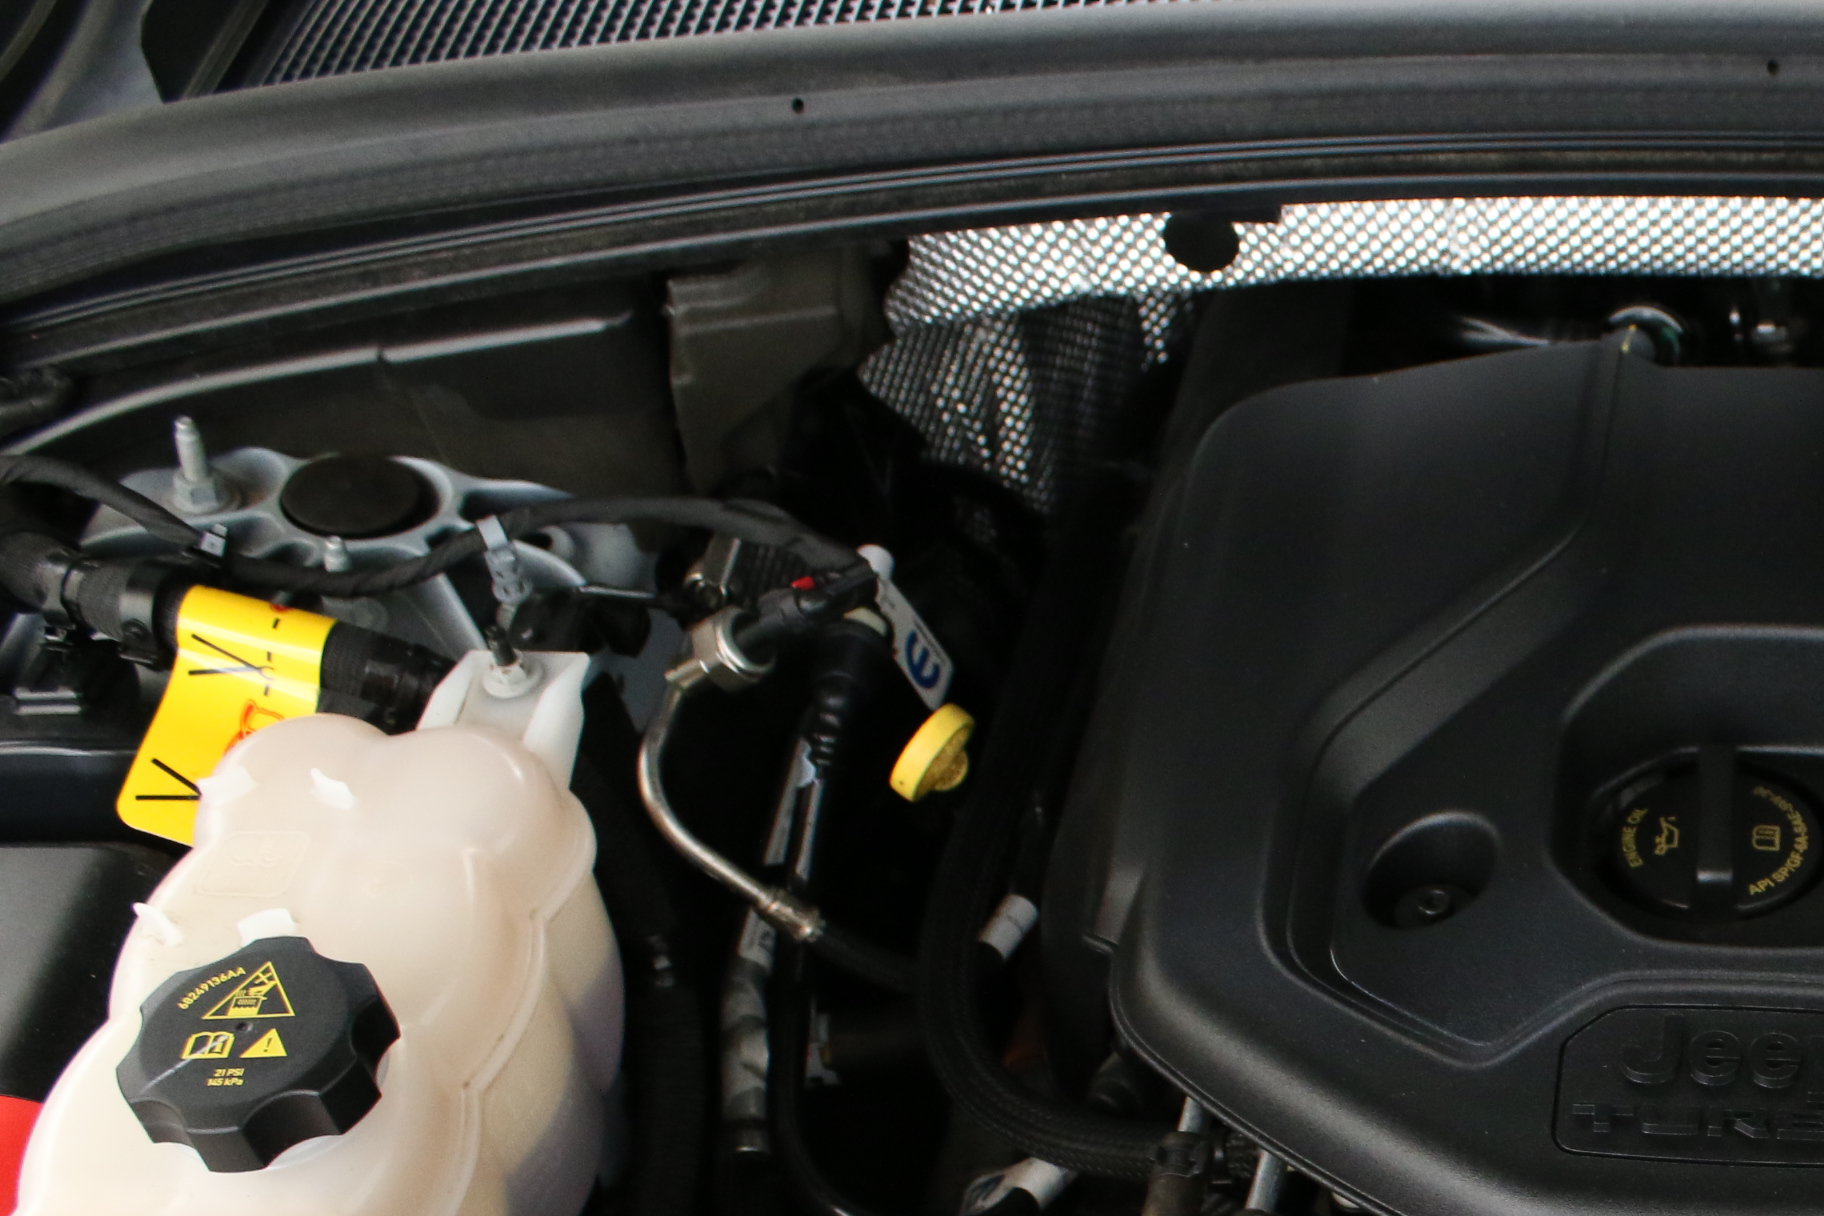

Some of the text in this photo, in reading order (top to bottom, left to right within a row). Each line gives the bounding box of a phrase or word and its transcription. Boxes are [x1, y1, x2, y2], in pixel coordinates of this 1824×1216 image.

[1620, 808, 1649, 868] ENGINE OIL
[1747, 877, 1775, 896] API
[177, 966, 246, 1010] 68249136AA
[213, 1067, 245, 1077] 21 PSI
[223, 1077, 244, 1087] kPa
